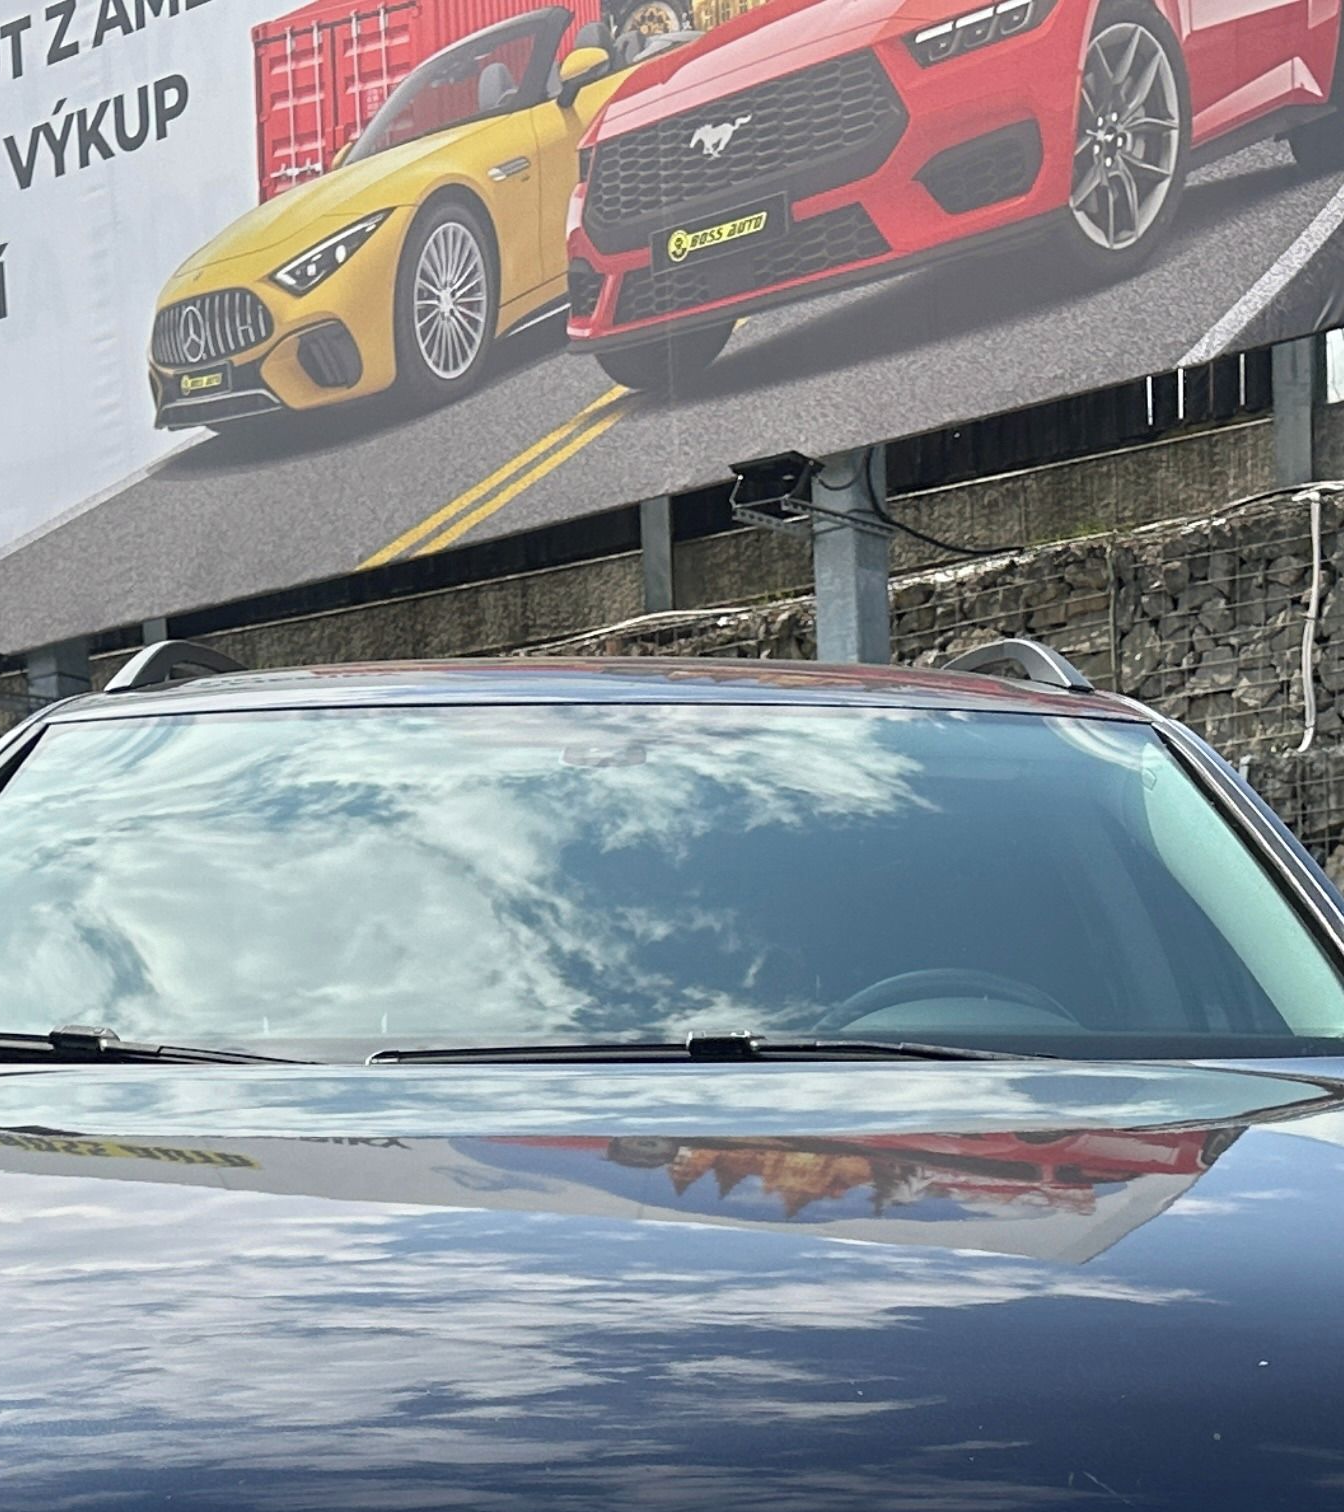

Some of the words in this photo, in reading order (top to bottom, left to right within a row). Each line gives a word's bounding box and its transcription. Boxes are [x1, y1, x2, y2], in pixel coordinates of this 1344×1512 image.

[46, 0, 79, 65] Z
[3, 73, 189, 190] VÝKUP
[690, 227, 723, 248] BOSS
[727, 215, 763, 236] AUTO
